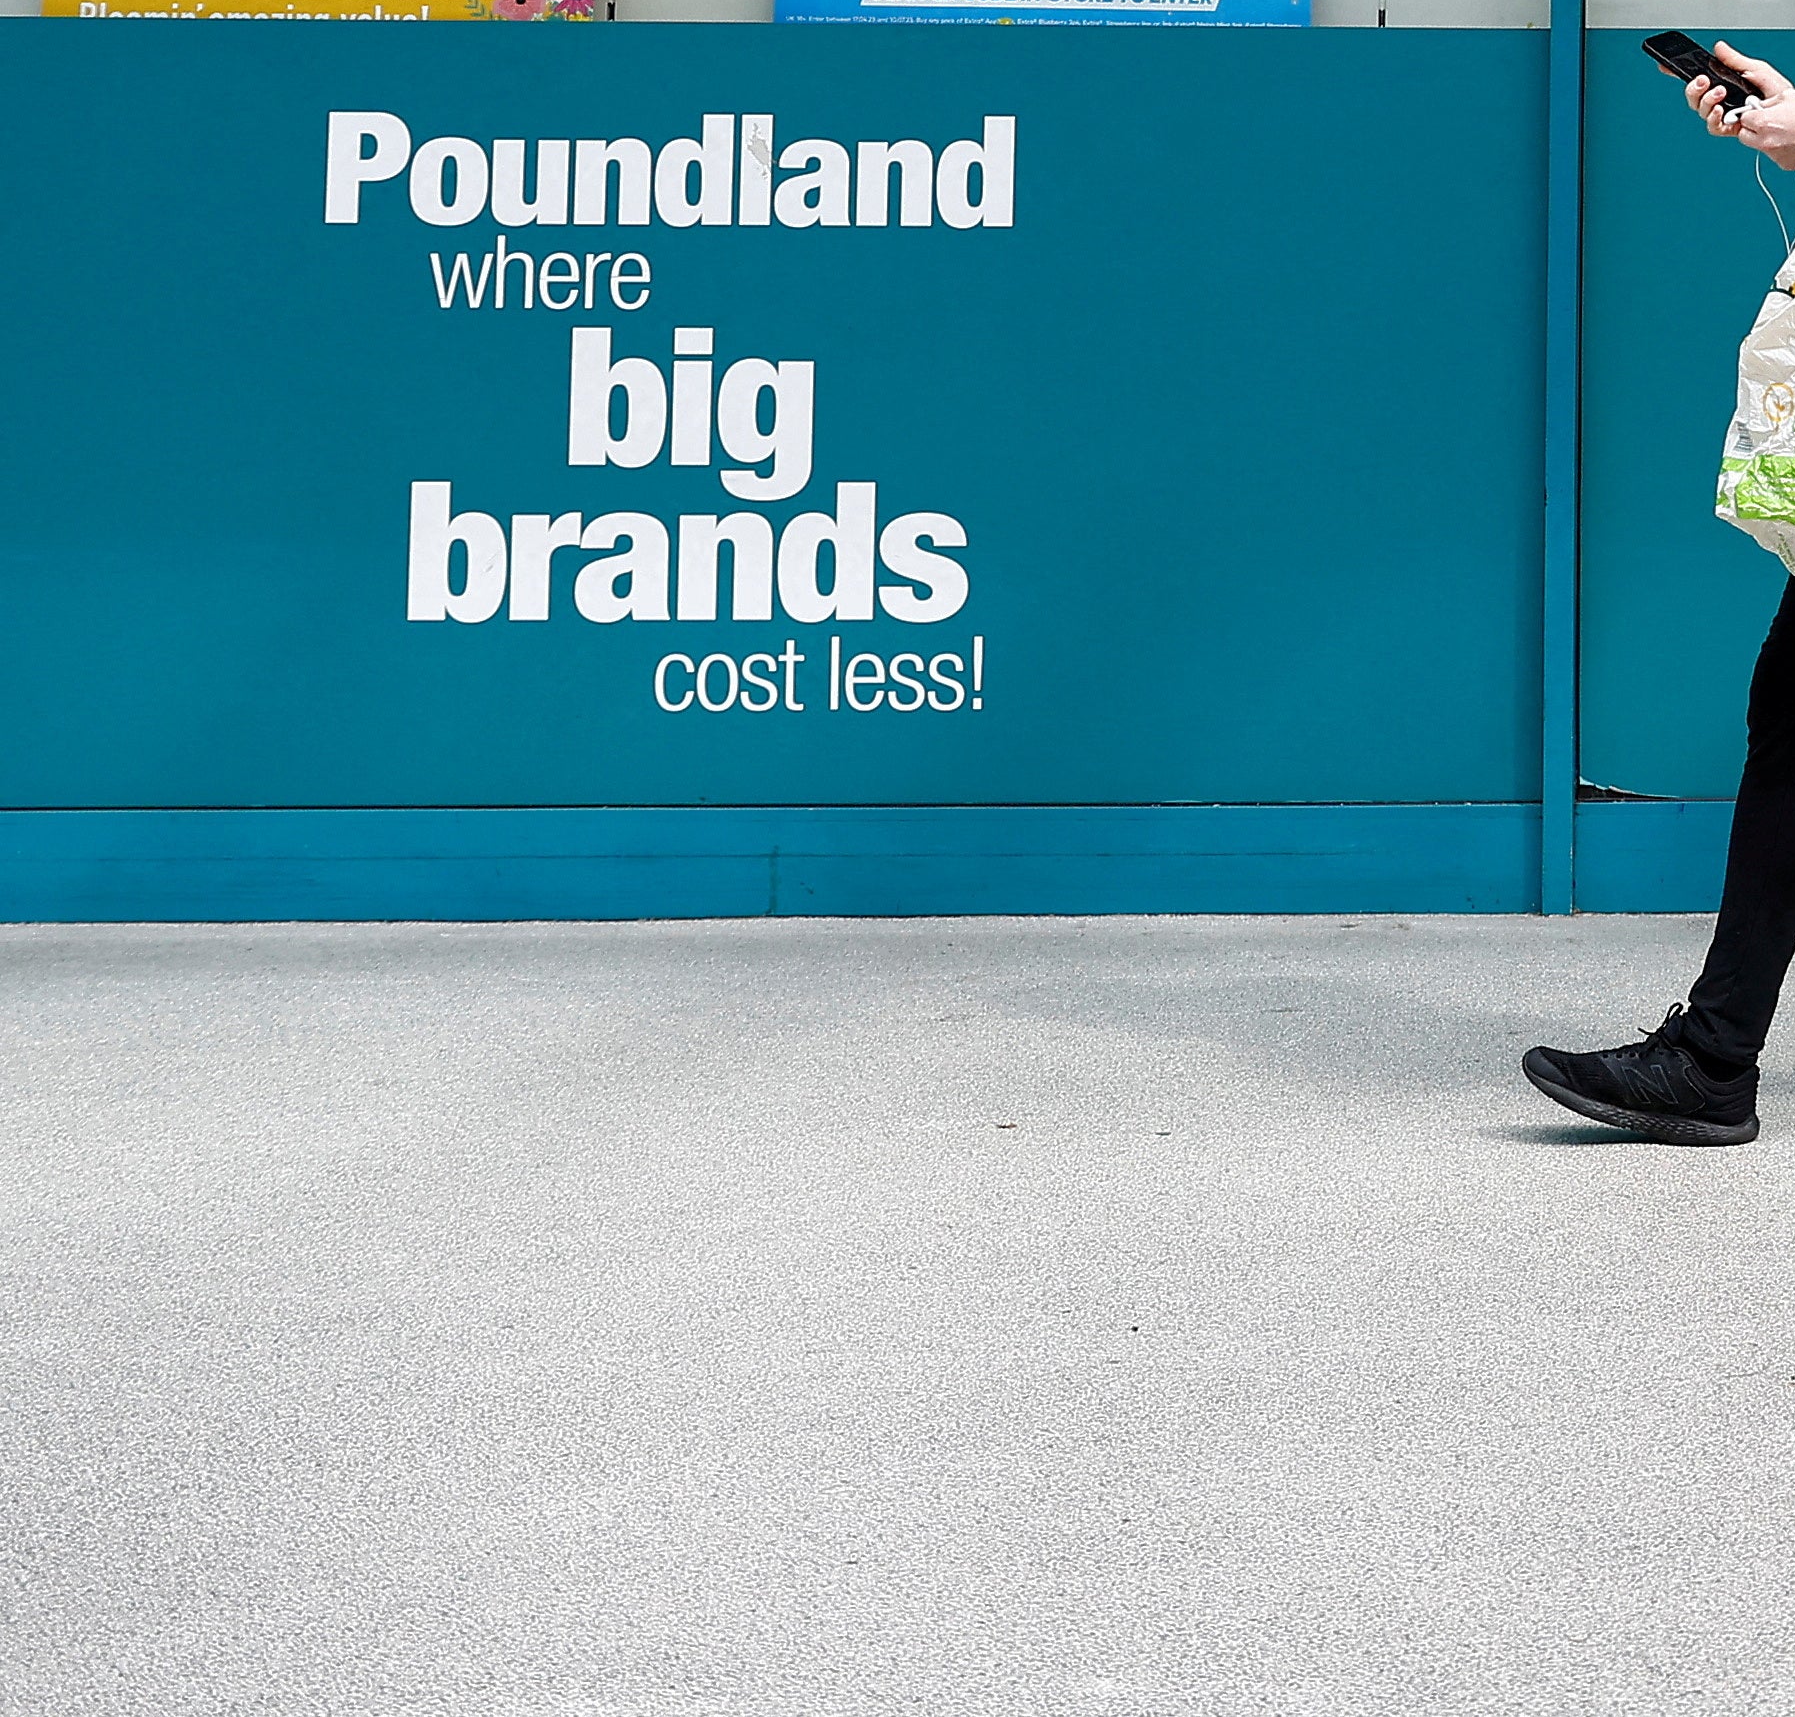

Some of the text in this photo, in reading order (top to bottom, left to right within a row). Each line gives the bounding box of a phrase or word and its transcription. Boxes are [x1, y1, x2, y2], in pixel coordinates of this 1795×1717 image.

[323, 110, 1017, 229] Poundland
[429, 233, 652, 310] where
[567, 326, 816, 501] big
[406, 480, 970, 624] brands
[652, 635, 985, 712] cost less!
